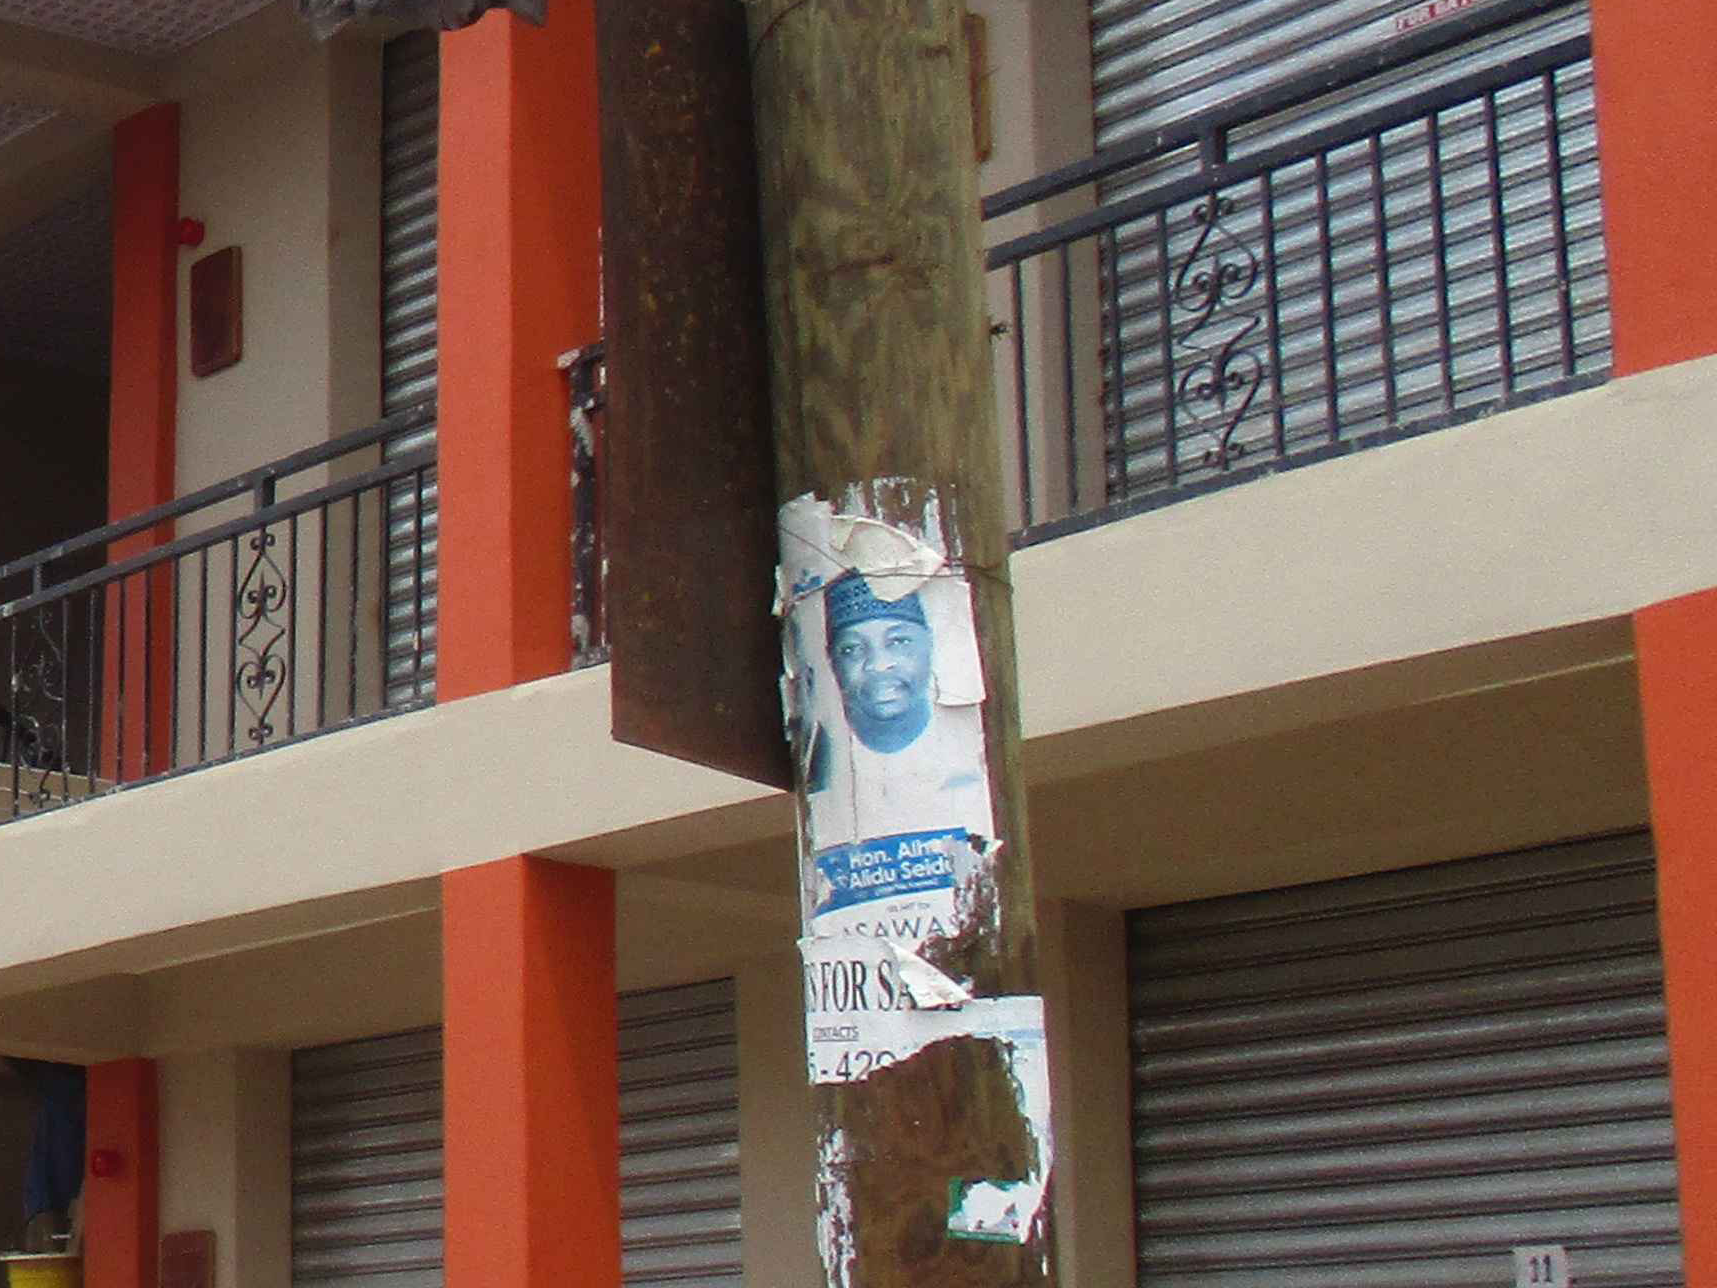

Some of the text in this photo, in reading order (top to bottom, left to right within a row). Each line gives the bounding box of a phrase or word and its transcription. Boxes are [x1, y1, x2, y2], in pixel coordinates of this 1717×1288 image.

[849, 850, 893, 869] Hon.
[850, 867, 897, 889] Alidu
[820, 960, 869, 1012] FOR
[1529, 1255, 1552, 1283] 11
